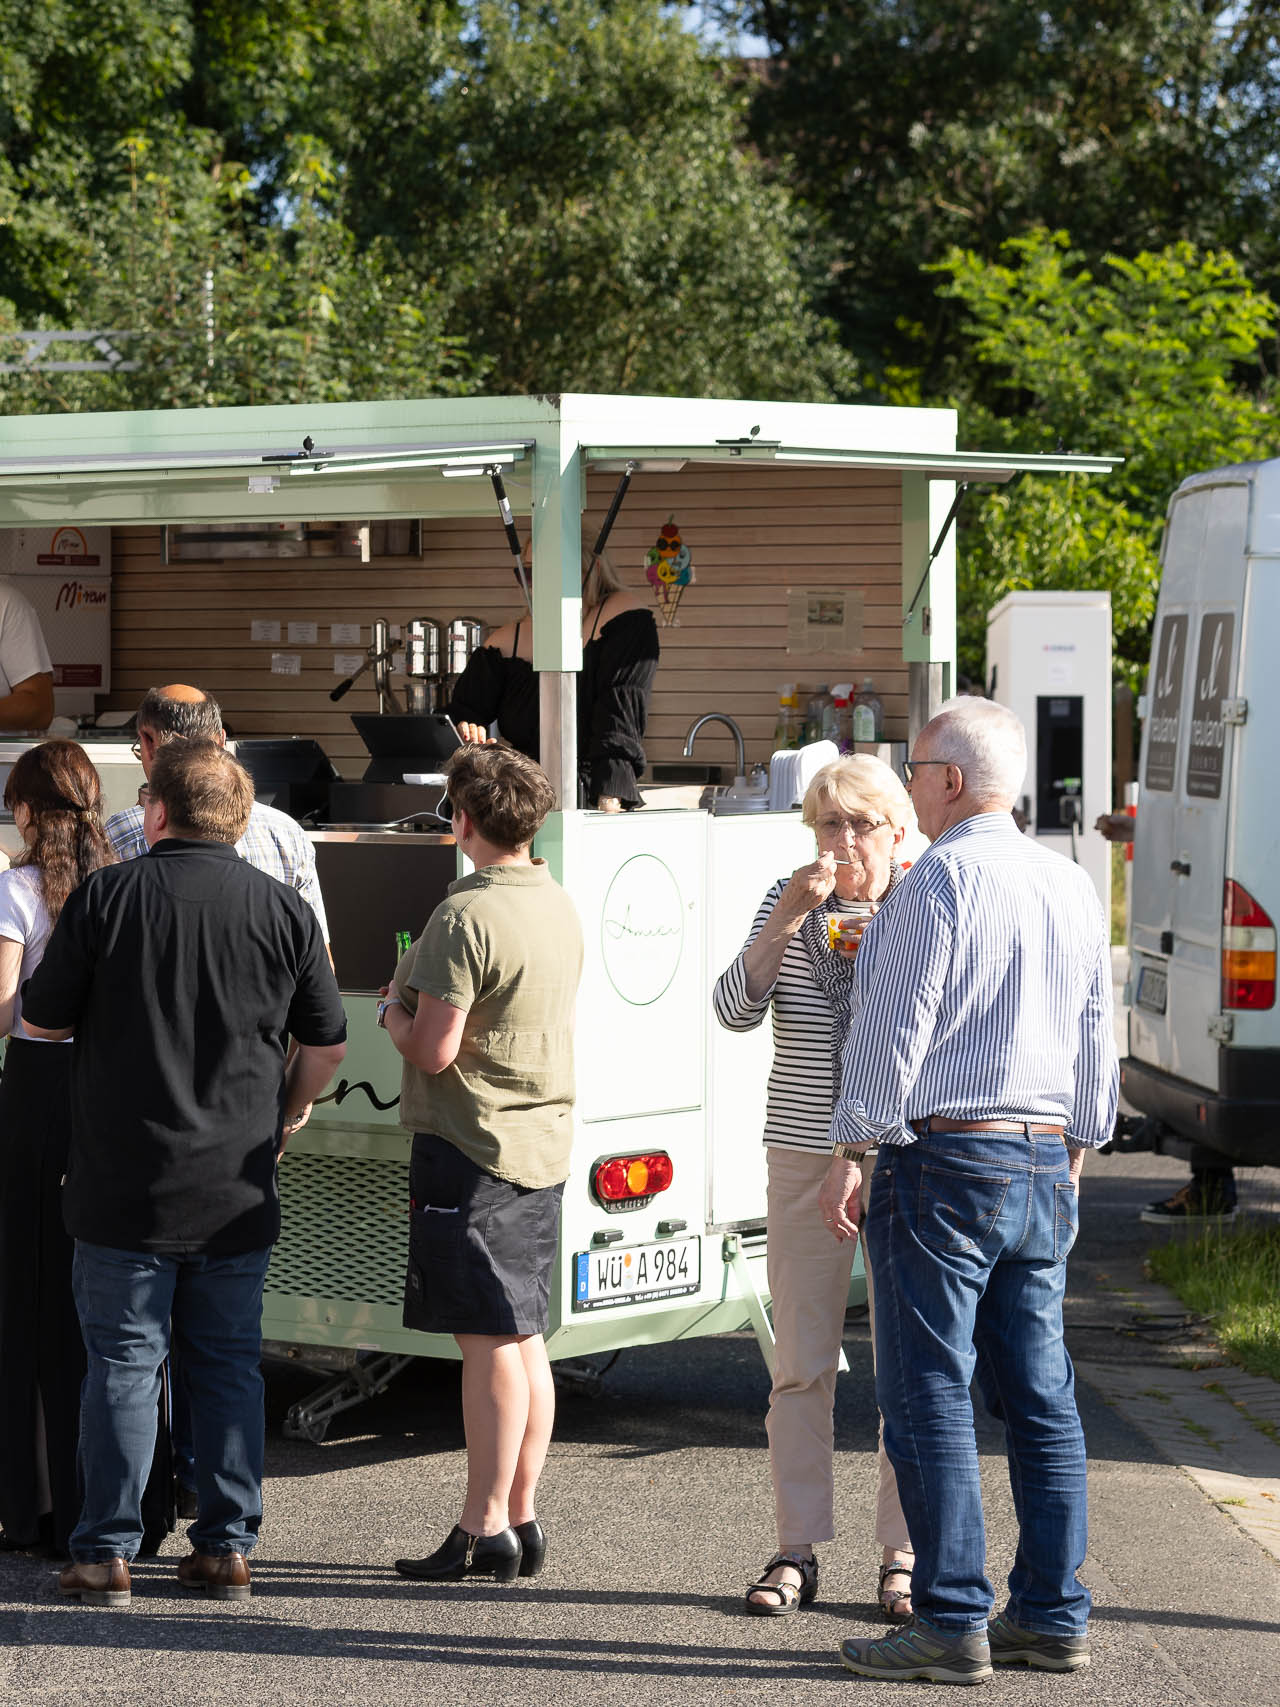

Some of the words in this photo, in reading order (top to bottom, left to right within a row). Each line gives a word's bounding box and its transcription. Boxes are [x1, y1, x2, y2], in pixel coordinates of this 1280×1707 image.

[55, 581, 107, 612] Miran
[598, 1255, 623, 1292] WÜ
[636, 1251, 648, 1286] A
[654, 1246, 689, 1283] 984
